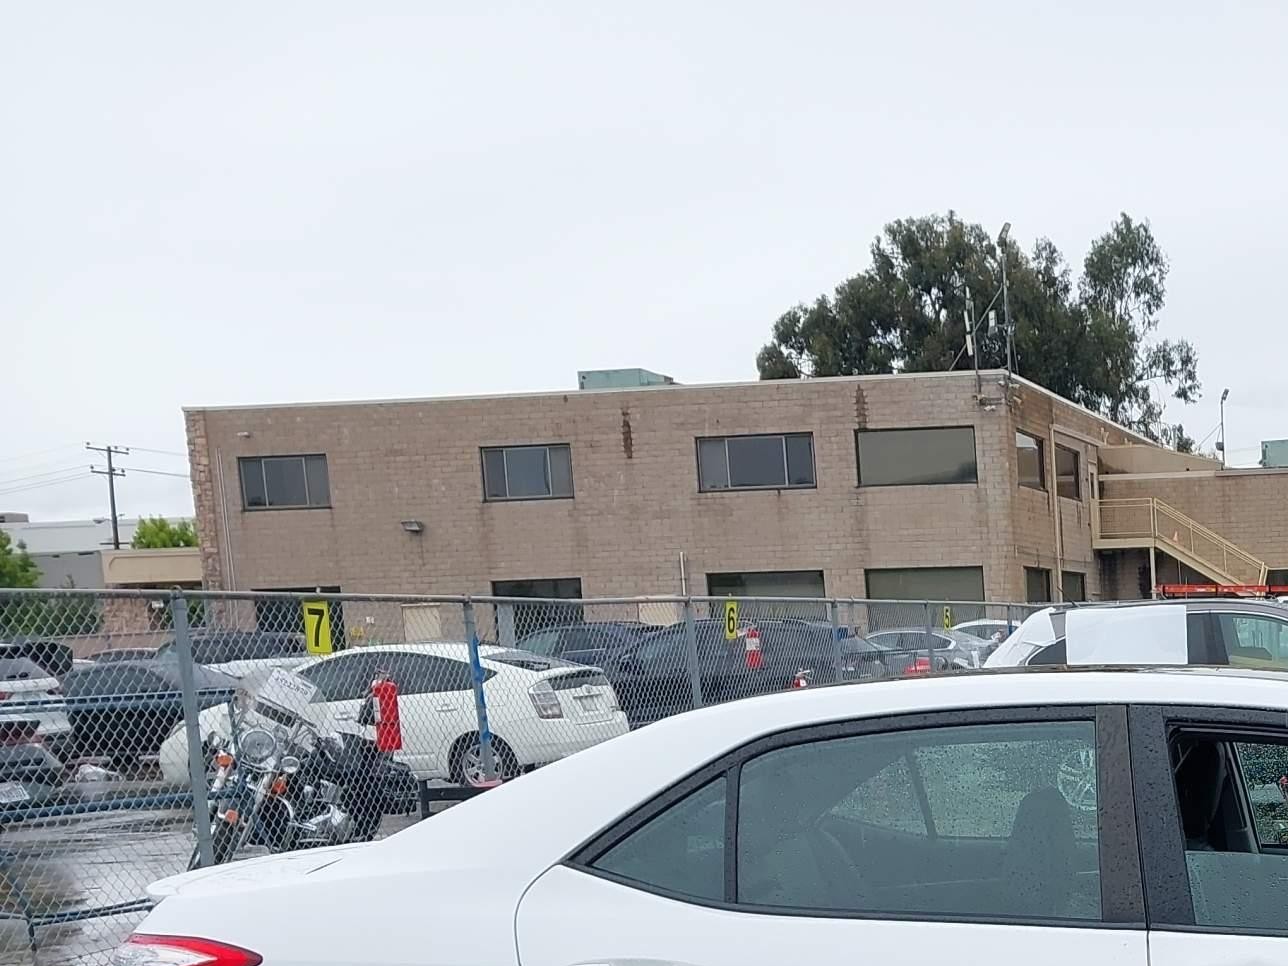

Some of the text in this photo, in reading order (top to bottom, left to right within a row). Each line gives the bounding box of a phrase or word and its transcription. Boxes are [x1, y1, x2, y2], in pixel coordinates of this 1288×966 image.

[307, 607, 325, 648] 7
[727, 607, 735, 634] 6
[945, 608, 950, 628] 5
